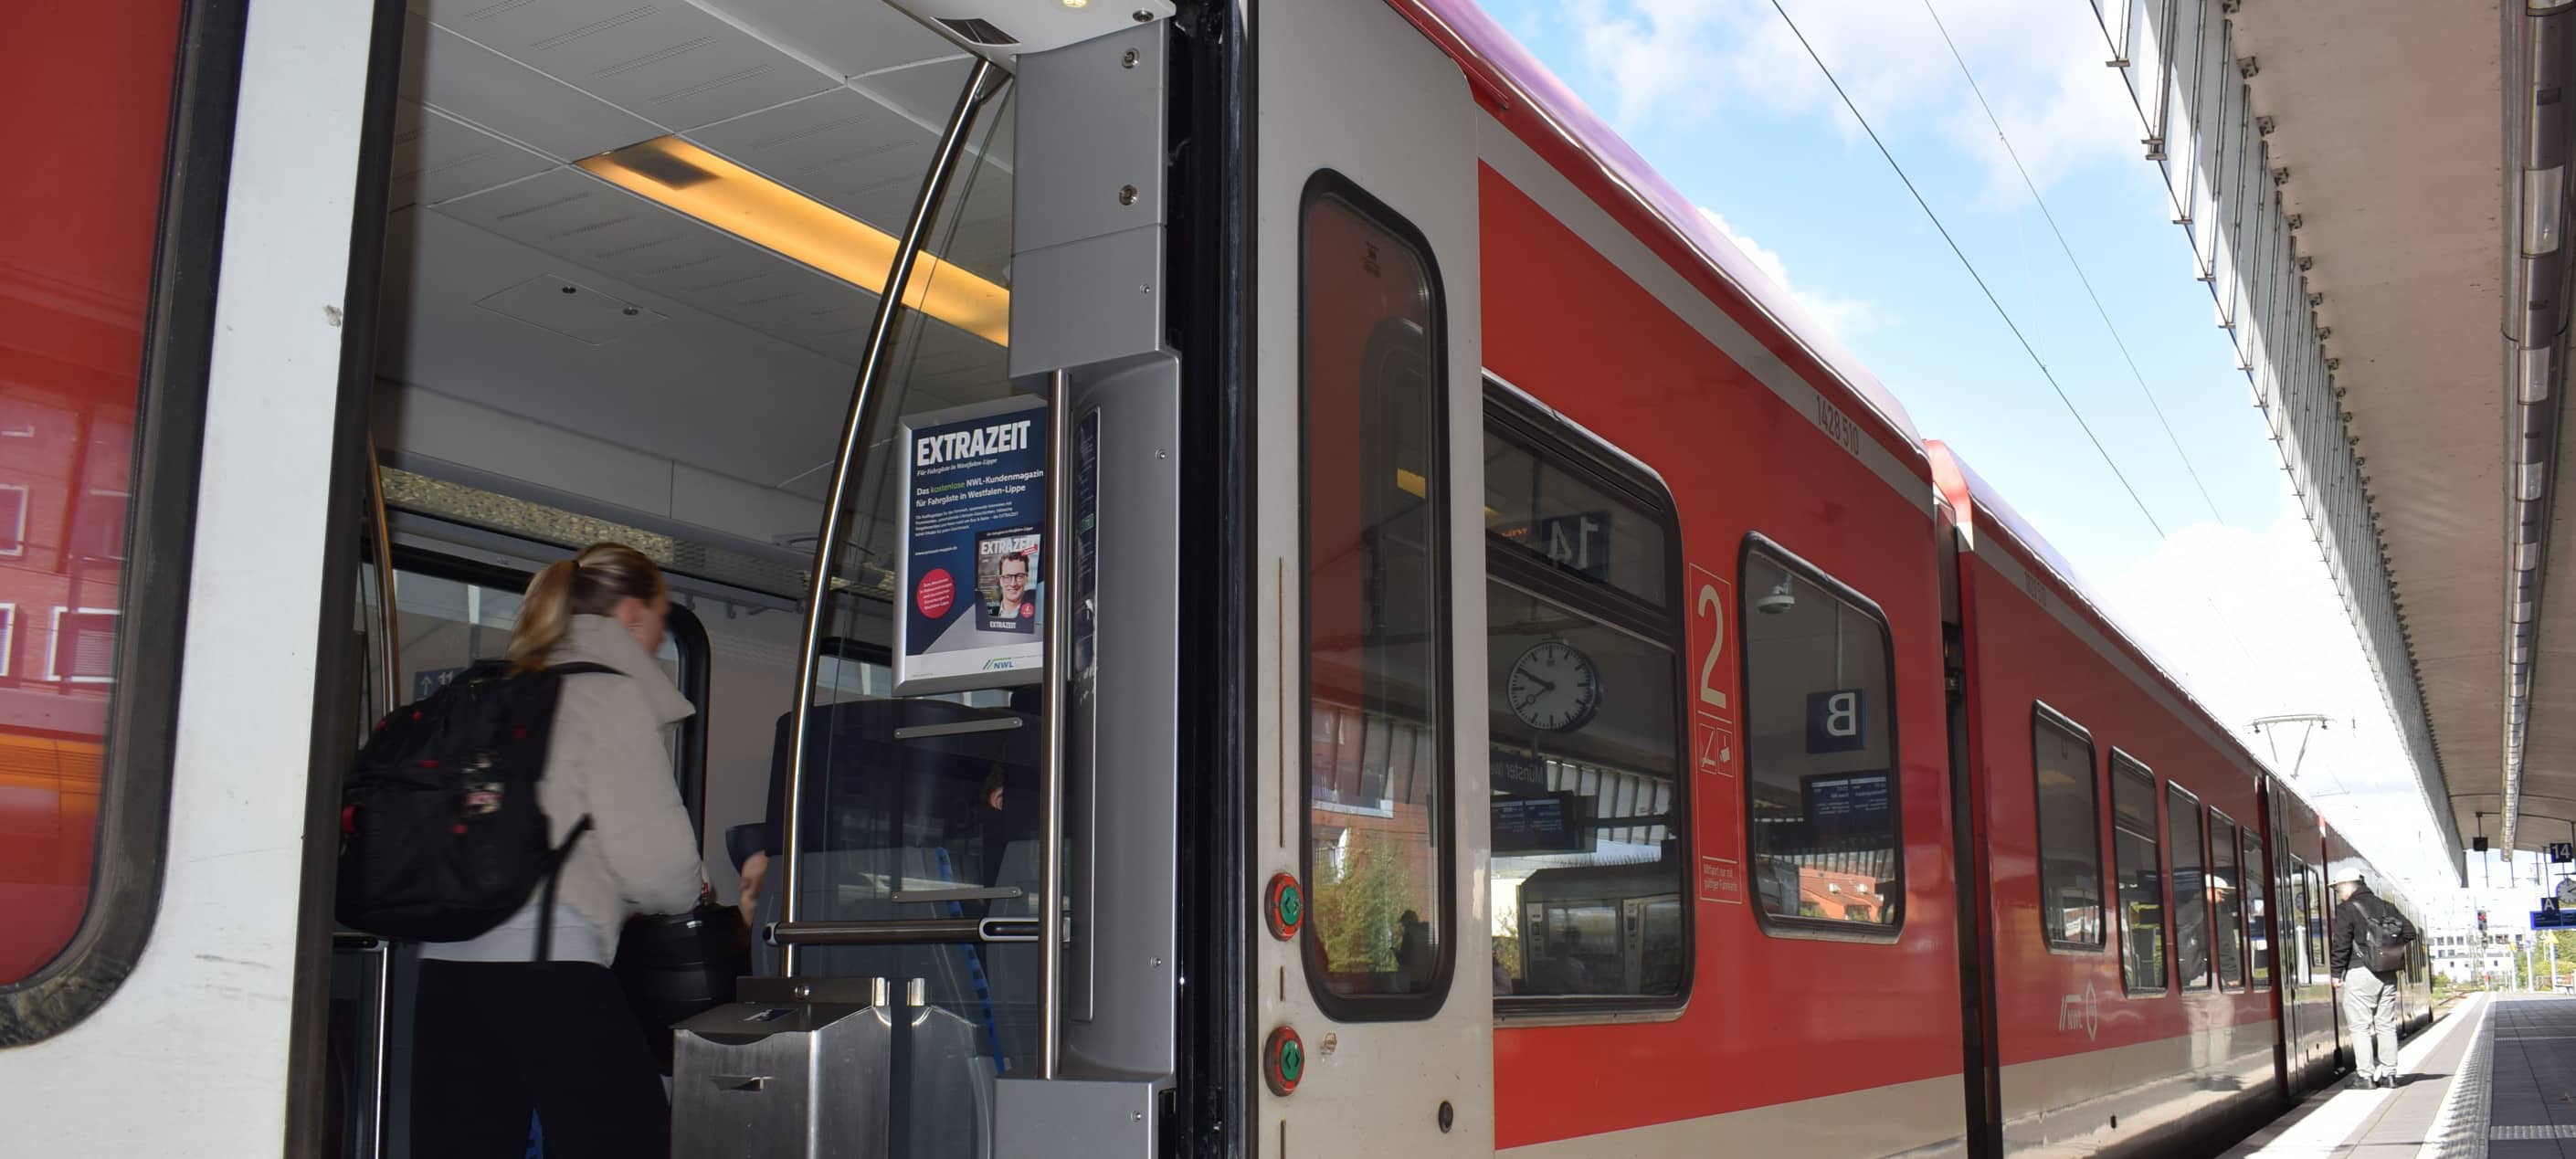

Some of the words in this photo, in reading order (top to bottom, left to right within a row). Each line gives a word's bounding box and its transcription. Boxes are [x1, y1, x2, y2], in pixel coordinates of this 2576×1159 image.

[1817, 395, 1841, 440] 1428
[1842, 416, 1859, 455] 510
[917, 420, 1030, 466] EXTRAZEIT
[915, 499, 927, 507] für
[928, 494, 959, 505] Fahrgäste
[967, 485, 1026, 499] Westfalen-Lippe
[916, 487, 930, 496] Das
[931, 481, 966, 493] kostenlose
[966, 469, 1044, 488] NWL-Kundenmagazin
[1697, 584, 1726, 710] 2
[2552, 845, 2570, 859] 14
[2544, 899, 2555, 910] A
